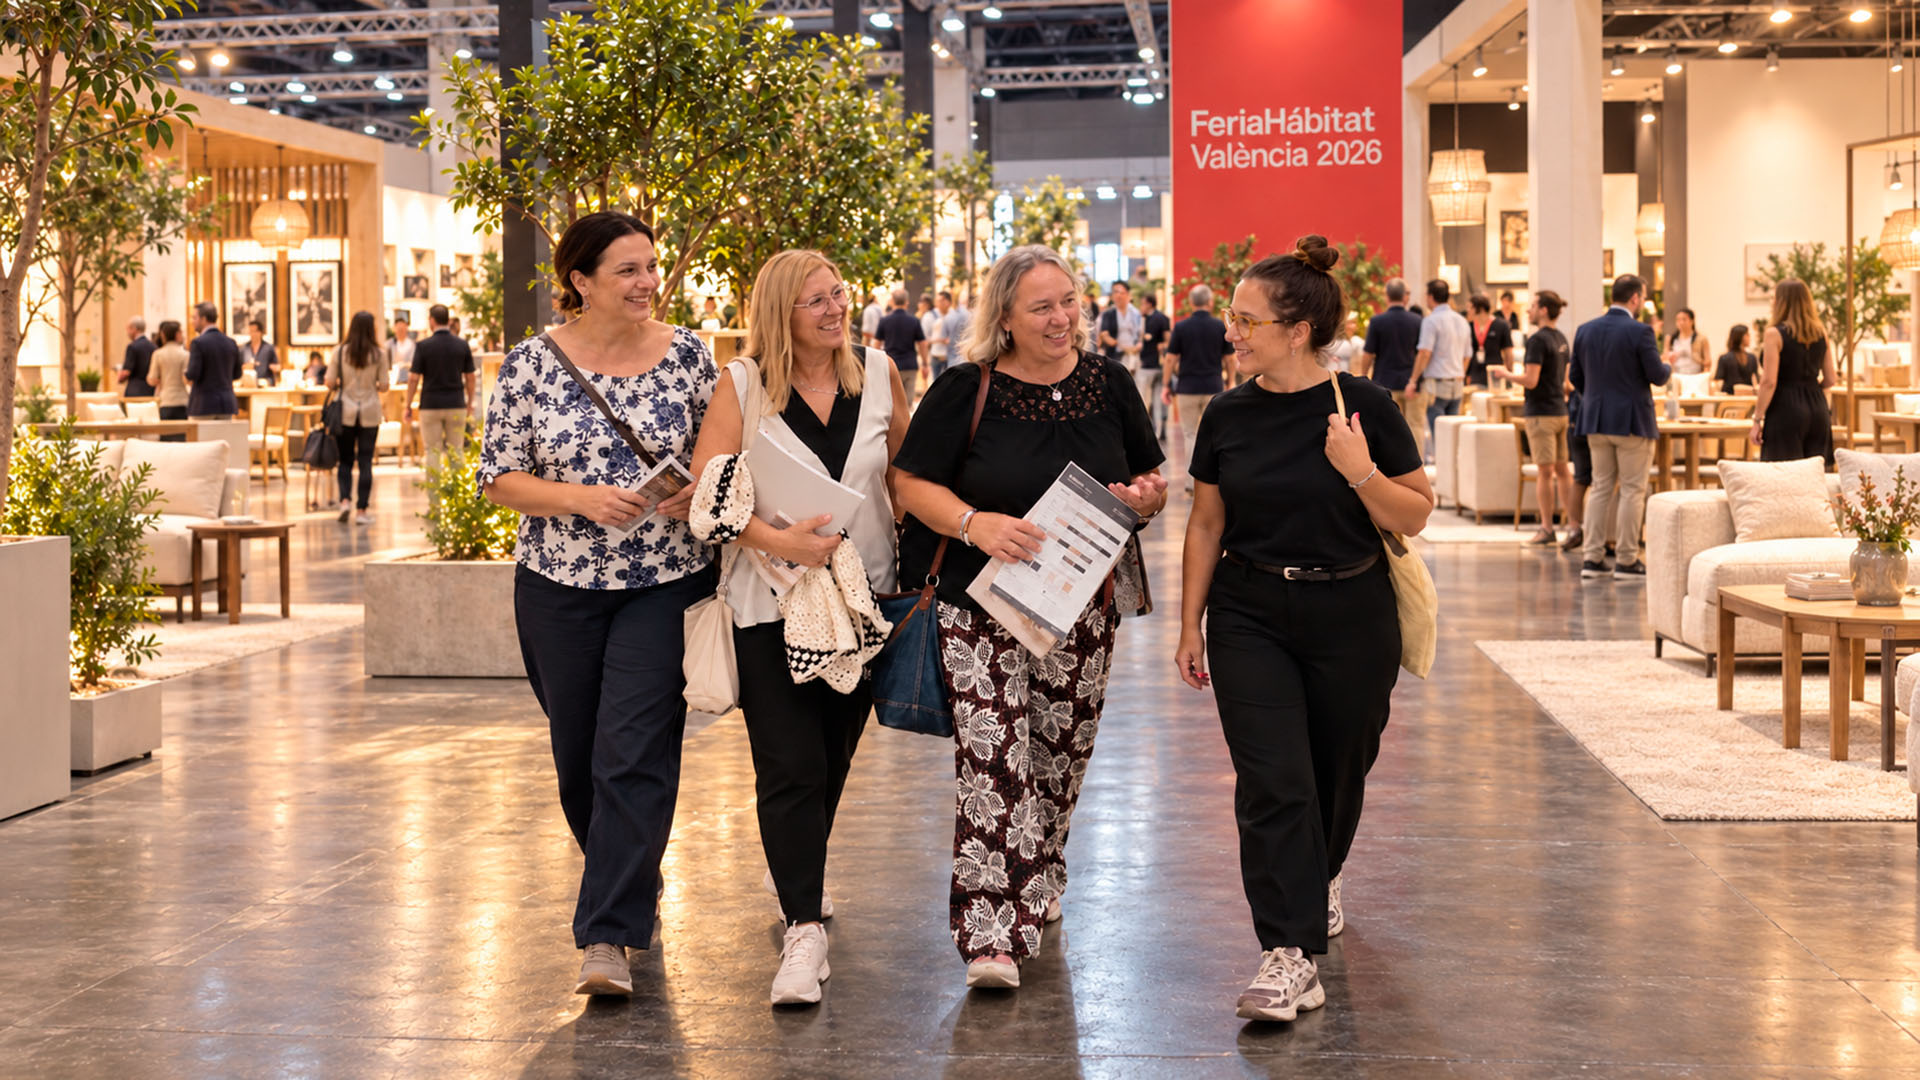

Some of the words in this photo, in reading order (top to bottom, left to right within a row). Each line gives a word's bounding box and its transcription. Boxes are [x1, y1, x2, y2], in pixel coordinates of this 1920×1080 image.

[1190, 106, 1375, 137] FeriaHábitat
[1191, 142, 1308, 169] València
[1317, 139, 1382, 166] 2026
